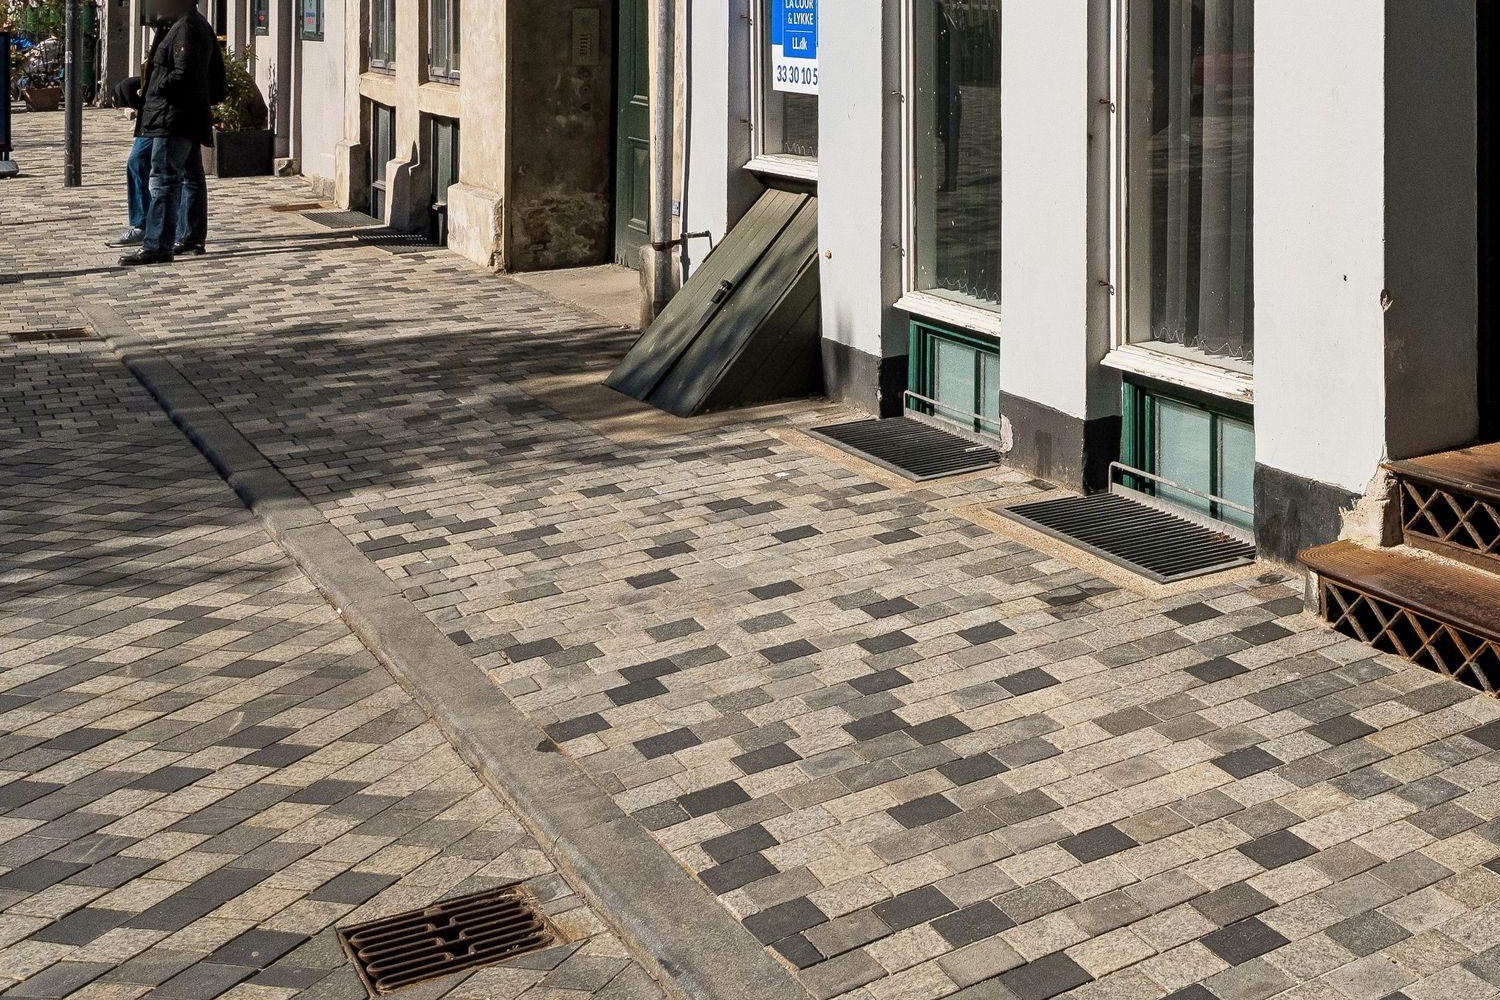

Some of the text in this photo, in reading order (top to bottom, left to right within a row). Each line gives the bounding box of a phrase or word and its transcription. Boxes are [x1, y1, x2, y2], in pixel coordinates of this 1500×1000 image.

[788, 12, 813, 25] & LYKKE
[777, 65, 787, 82] 33
[789, 66, 799, 83] 30
[801, 67, 811, 85] 10
